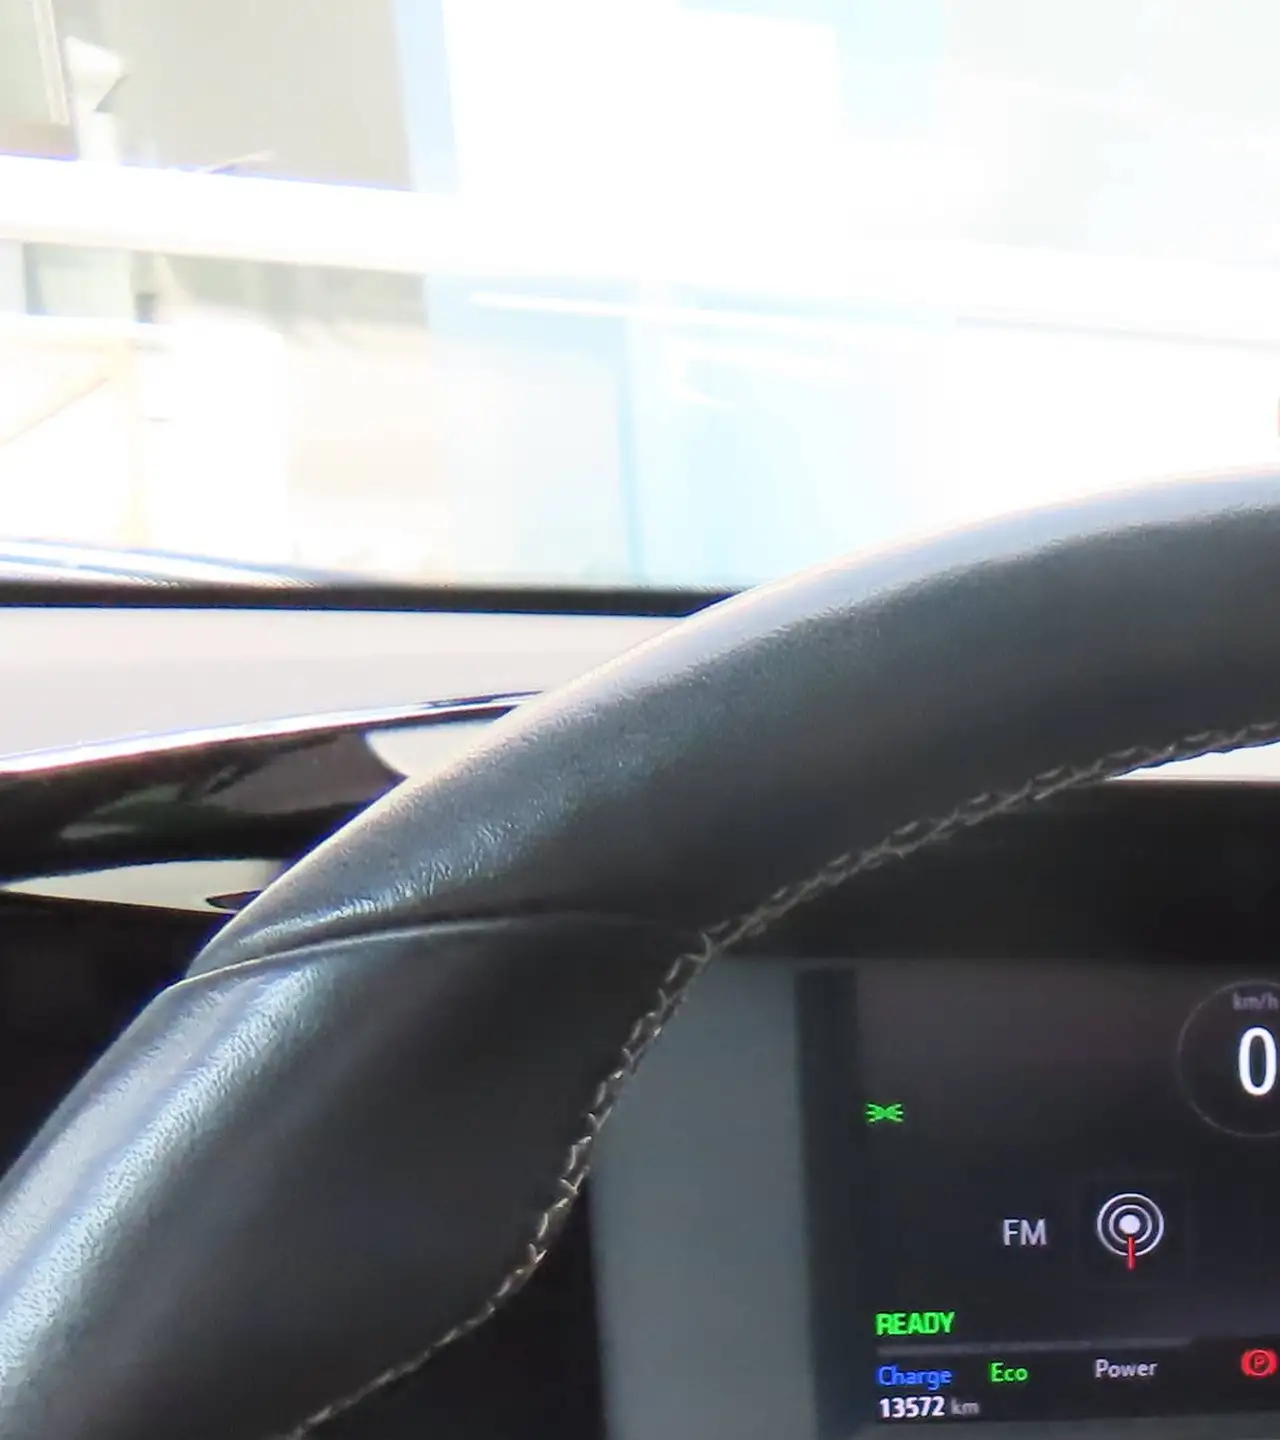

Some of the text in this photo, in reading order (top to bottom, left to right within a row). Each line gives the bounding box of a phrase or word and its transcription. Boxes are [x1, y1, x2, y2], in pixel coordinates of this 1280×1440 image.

[1231, 992, 1280, 1010] km/h
[1238, 1026, 1278, 1097] 0
[1003, 1219, 1047, 1246] FM
[875, 1312, 956, 1335] READY
[877, 1366, 952, 1390] Charge
[990, 1362, 1028, 1382] Eco
[1095, 1359, 1158, 1378] Power
[879, 1397, 981, 1418] 13572 km
